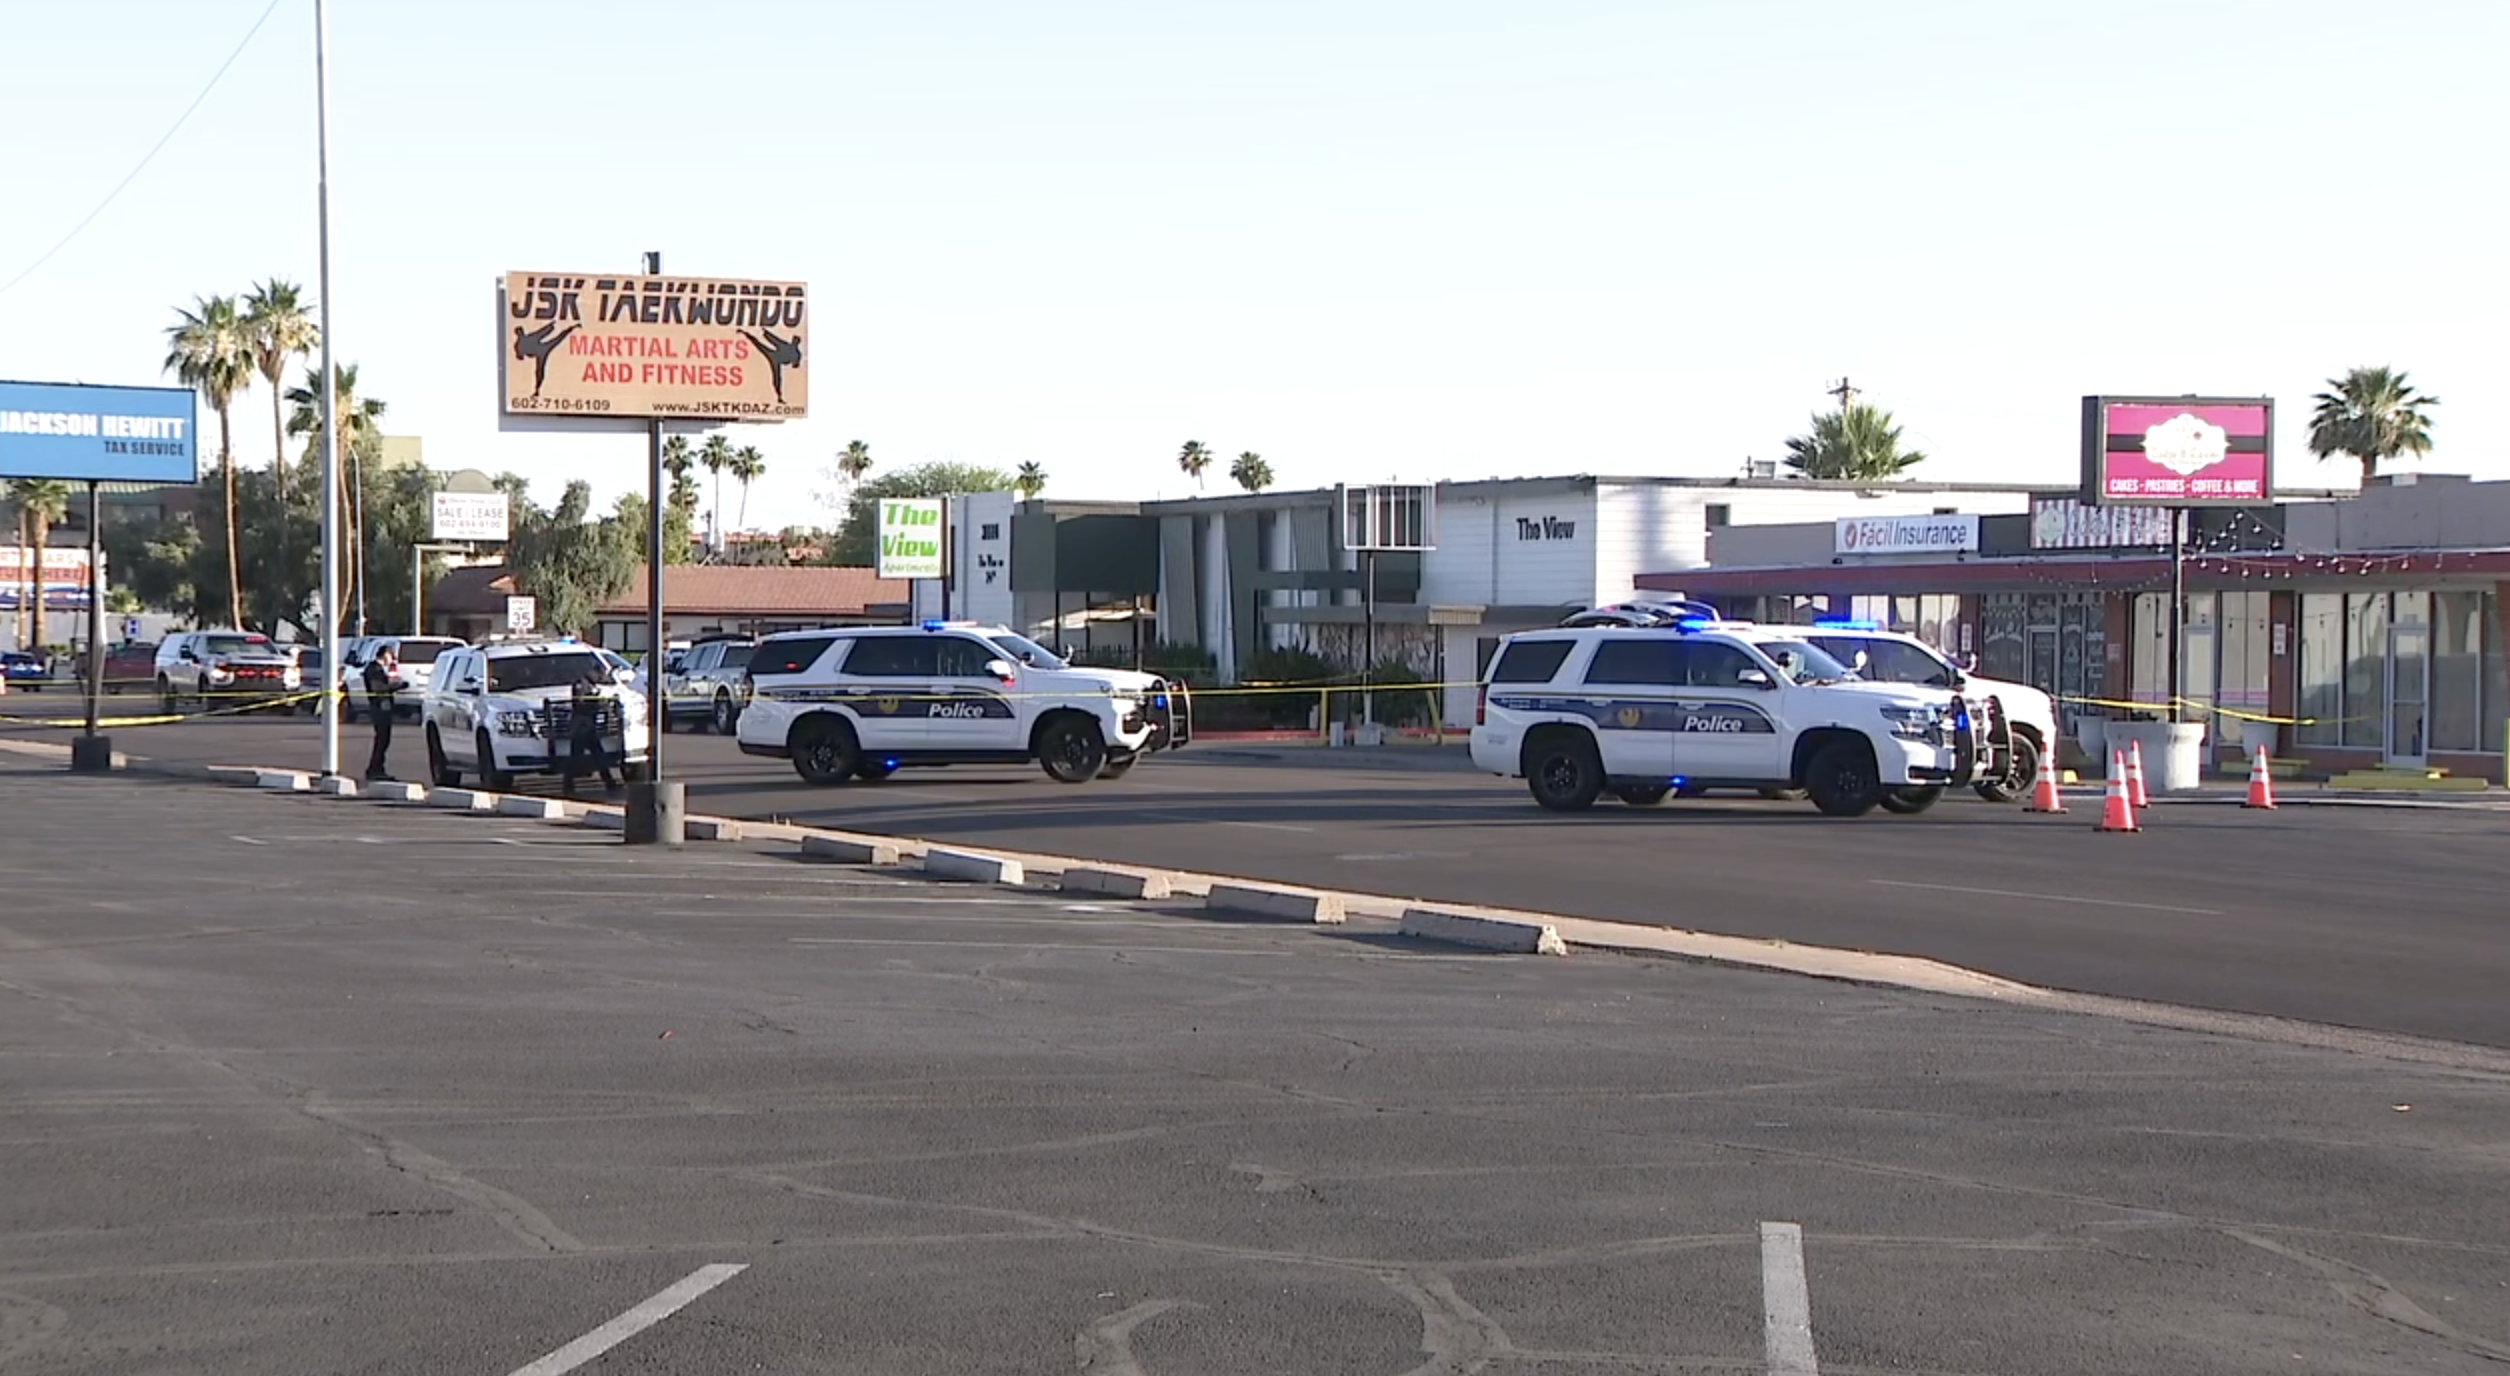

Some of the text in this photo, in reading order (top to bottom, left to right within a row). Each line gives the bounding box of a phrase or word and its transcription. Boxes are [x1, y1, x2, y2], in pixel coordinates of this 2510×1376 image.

[512, 277, 804, 327] JSK TAEKWONDO
[569, 335, 749, 360] MARTIAL ARTS
[582, 362, 743, 386] AND FITNESS
[511, 398, 610, 411] 602-710-6109
[652, 402, 805, 415] www.JSKTKDAZ.com
[0, 411, 184, 439] JACKSON HEWITT
[104, 441, 184, 456] TAX SERVICE
[2109, 479, 2138, 492] CAKES
[2145, 479, 2185, 492] PASTRIES
[2191, 480, 2222, 493] COFFEE
[2233, 480, 2258, 493] MORE
[437, 507, 462, 518] SALE
[471, 508, 504, 519] LEASE
[884, 503, 938, 525] The
[1516, 516, 1575, 540] The View
[882, 532, 938, 557] View
[512, 611, 531, 626] 35
[928, 702, 984, 718] Police
[1684, 716, 1742, 732] Police
